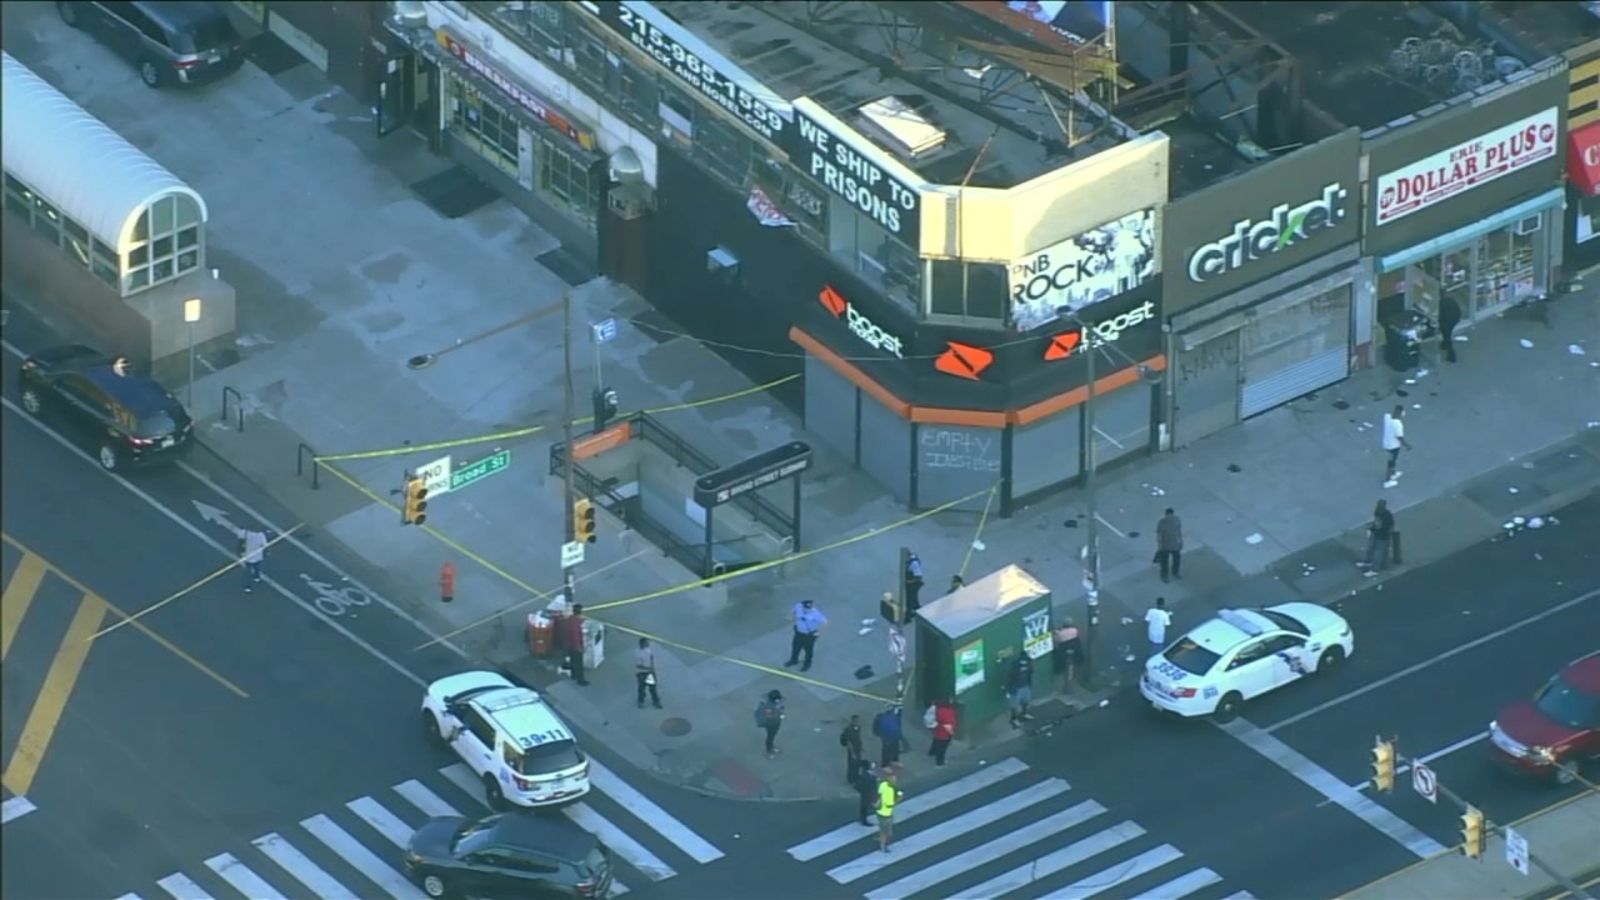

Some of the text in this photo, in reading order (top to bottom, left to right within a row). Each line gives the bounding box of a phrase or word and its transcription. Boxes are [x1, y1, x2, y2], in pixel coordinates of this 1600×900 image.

[618, 6, 783, 131] 215-965-1559
[631, 32, 672, 67] BLACK
[675, 64, 700, 87] AND
[798, 114, 915, 210] WE SHIP TO
[1396, 156, 1478, 204] DOLLAR
[1484, 124, 1537, 168] PLUS
[1450, 141, 1483, 162] ERIE
[811, 152, 901, 232] PRISONS
[1187, 182, 1347, 283] cricket
[1012, 254, 1051, 278] PNB
[1013, 254, 1095, 305] ROCK
[846, 301, 904, 360] boost
[452, 456, 505, 487] Broad St
